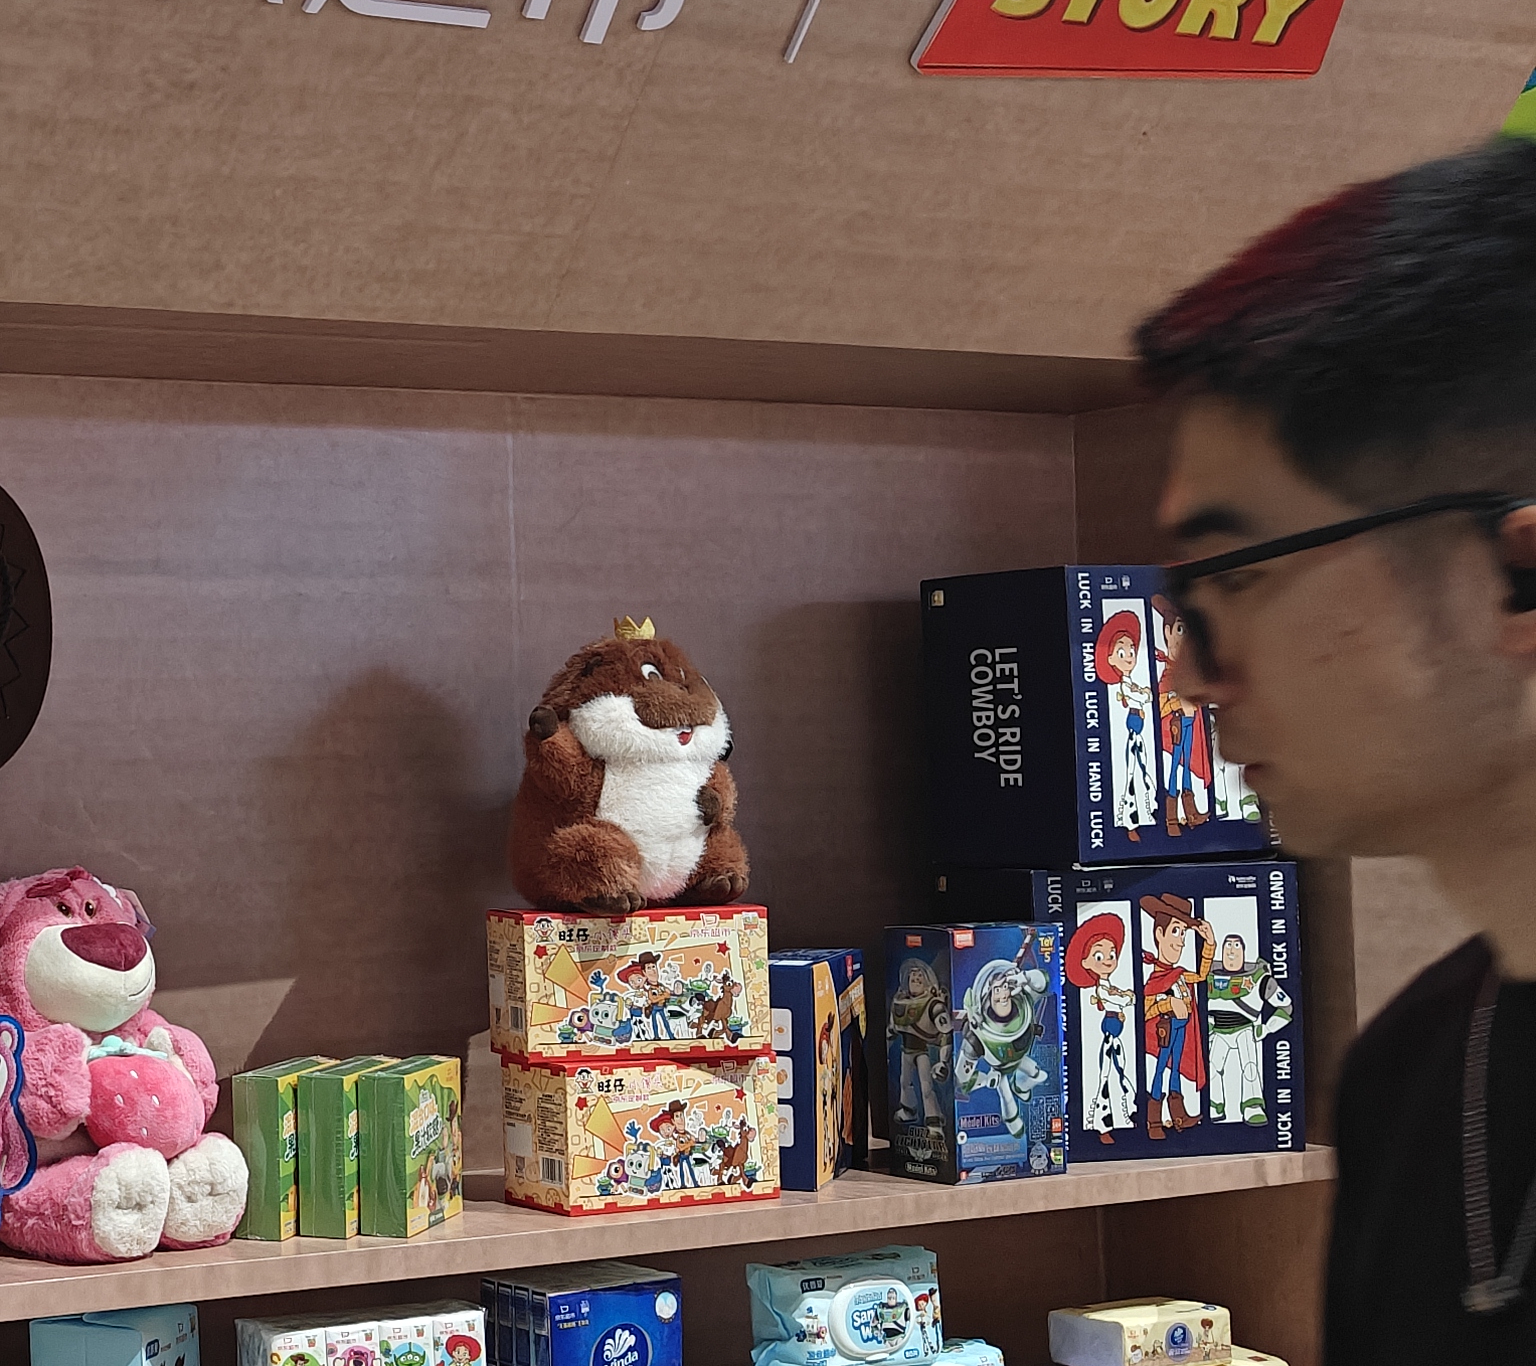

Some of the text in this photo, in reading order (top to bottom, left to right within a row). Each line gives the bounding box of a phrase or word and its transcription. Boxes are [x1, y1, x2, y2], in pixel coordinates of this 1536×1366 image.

[969, 648, 997, 763] COWBOY
[1077, 572, 1104, 849] LUCK IN HAND LUCK IN HAND LUCK
[997, 726, 1023, 788] RIDE
[558, 927, 589, 943] 旺仔
[1047, 876, 1062, 913] LUCK
[1269, 870, 1288, 980] LUCK IN HAND
[597, 1078, 625, 1092] 旺仔
[1276, 1040, 1292, 1149] LUCK IN HAND
